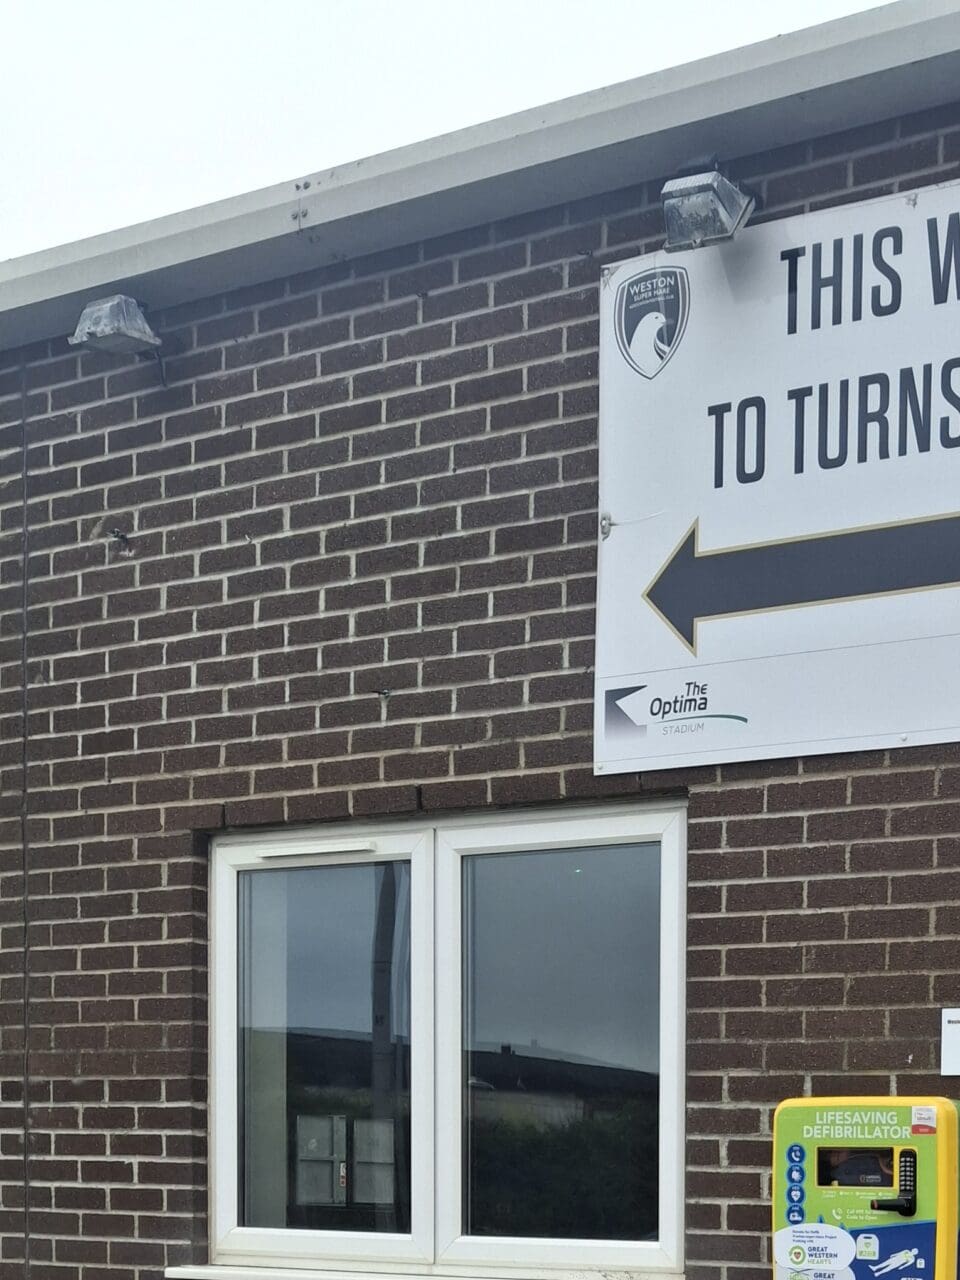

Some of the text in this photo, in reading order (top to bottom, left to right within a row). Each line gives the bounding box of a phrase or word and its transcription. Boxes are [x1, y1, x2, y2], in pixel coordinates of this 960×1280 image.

[629, 276, 675, 295] WESTON
[781, 226, 903, 335] THIS
[633, 290, 652, 302] SUPER
[707, 395, 767, 490] TO
[685, 681, 708, 697] The
[649, 694, 708, 720] Optima
[662, 723, 705, 736] STADIUM
[815, 1111, 898, 1124] LIFESAVING
[803, 1125, 911, 1139] DEFIBRILLATOR
